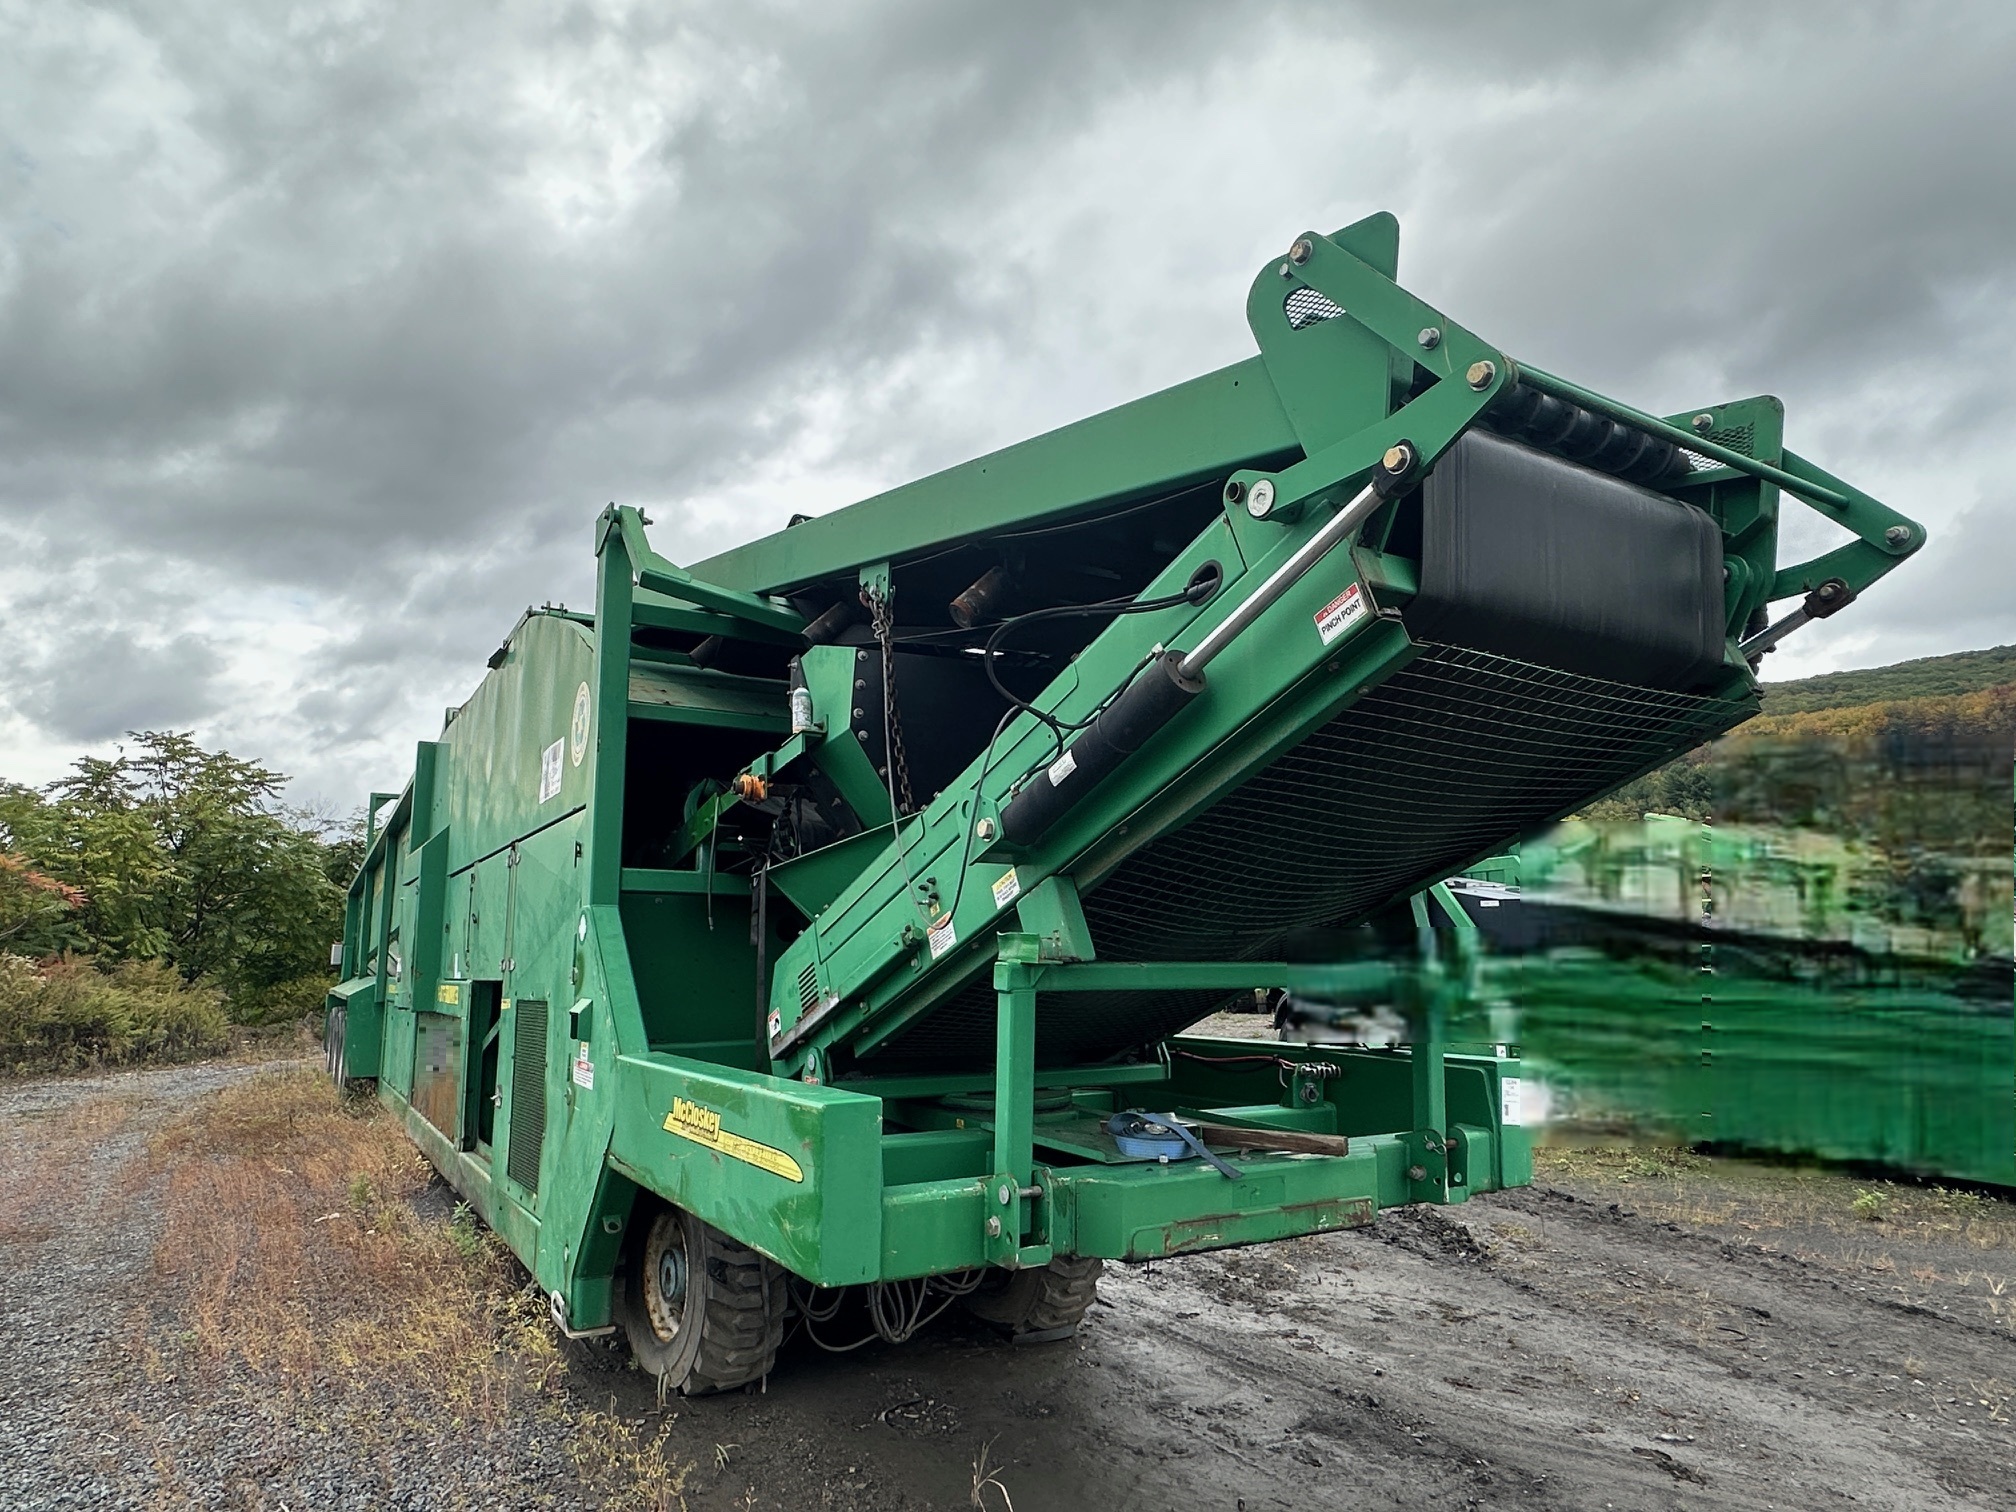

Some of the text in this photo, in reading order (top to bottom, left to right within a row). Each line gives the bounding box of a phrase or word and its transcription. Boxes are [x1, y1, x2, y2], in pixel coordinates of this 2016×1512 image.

[1321, 598, 1361, 635] PINCH POINT
[1326, 590, 1352, 612] DANGER
[673, 1095, 721, 1142] McCloskey
